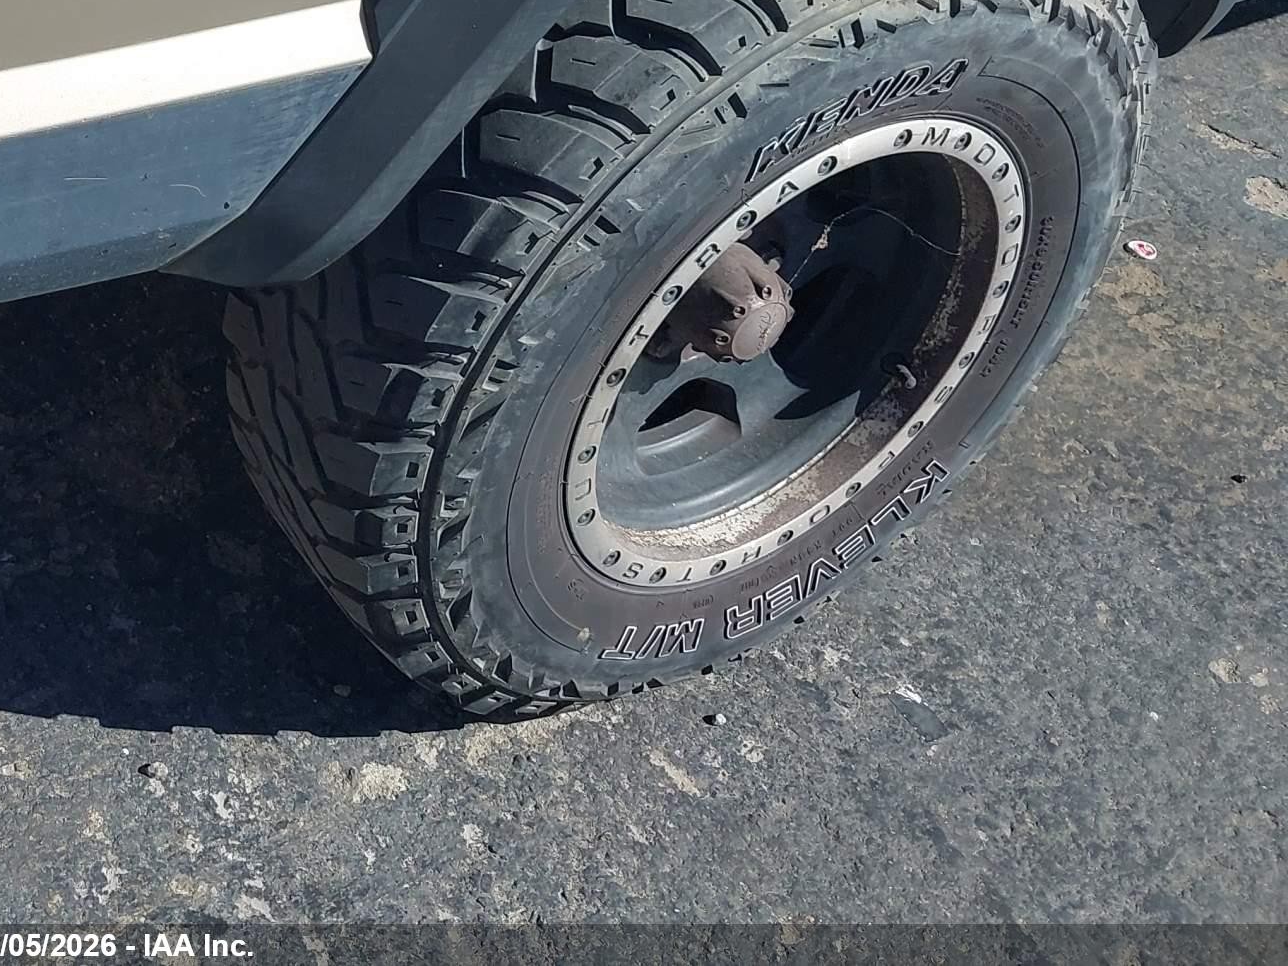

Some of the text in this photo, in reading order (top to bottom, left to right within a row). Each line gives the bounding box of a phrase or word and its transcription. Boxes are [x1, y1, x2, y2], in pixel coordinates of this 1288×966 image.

[744, 57, 969, 183] KENDA
[598, 457, 951, 660] KLEVER M/T
